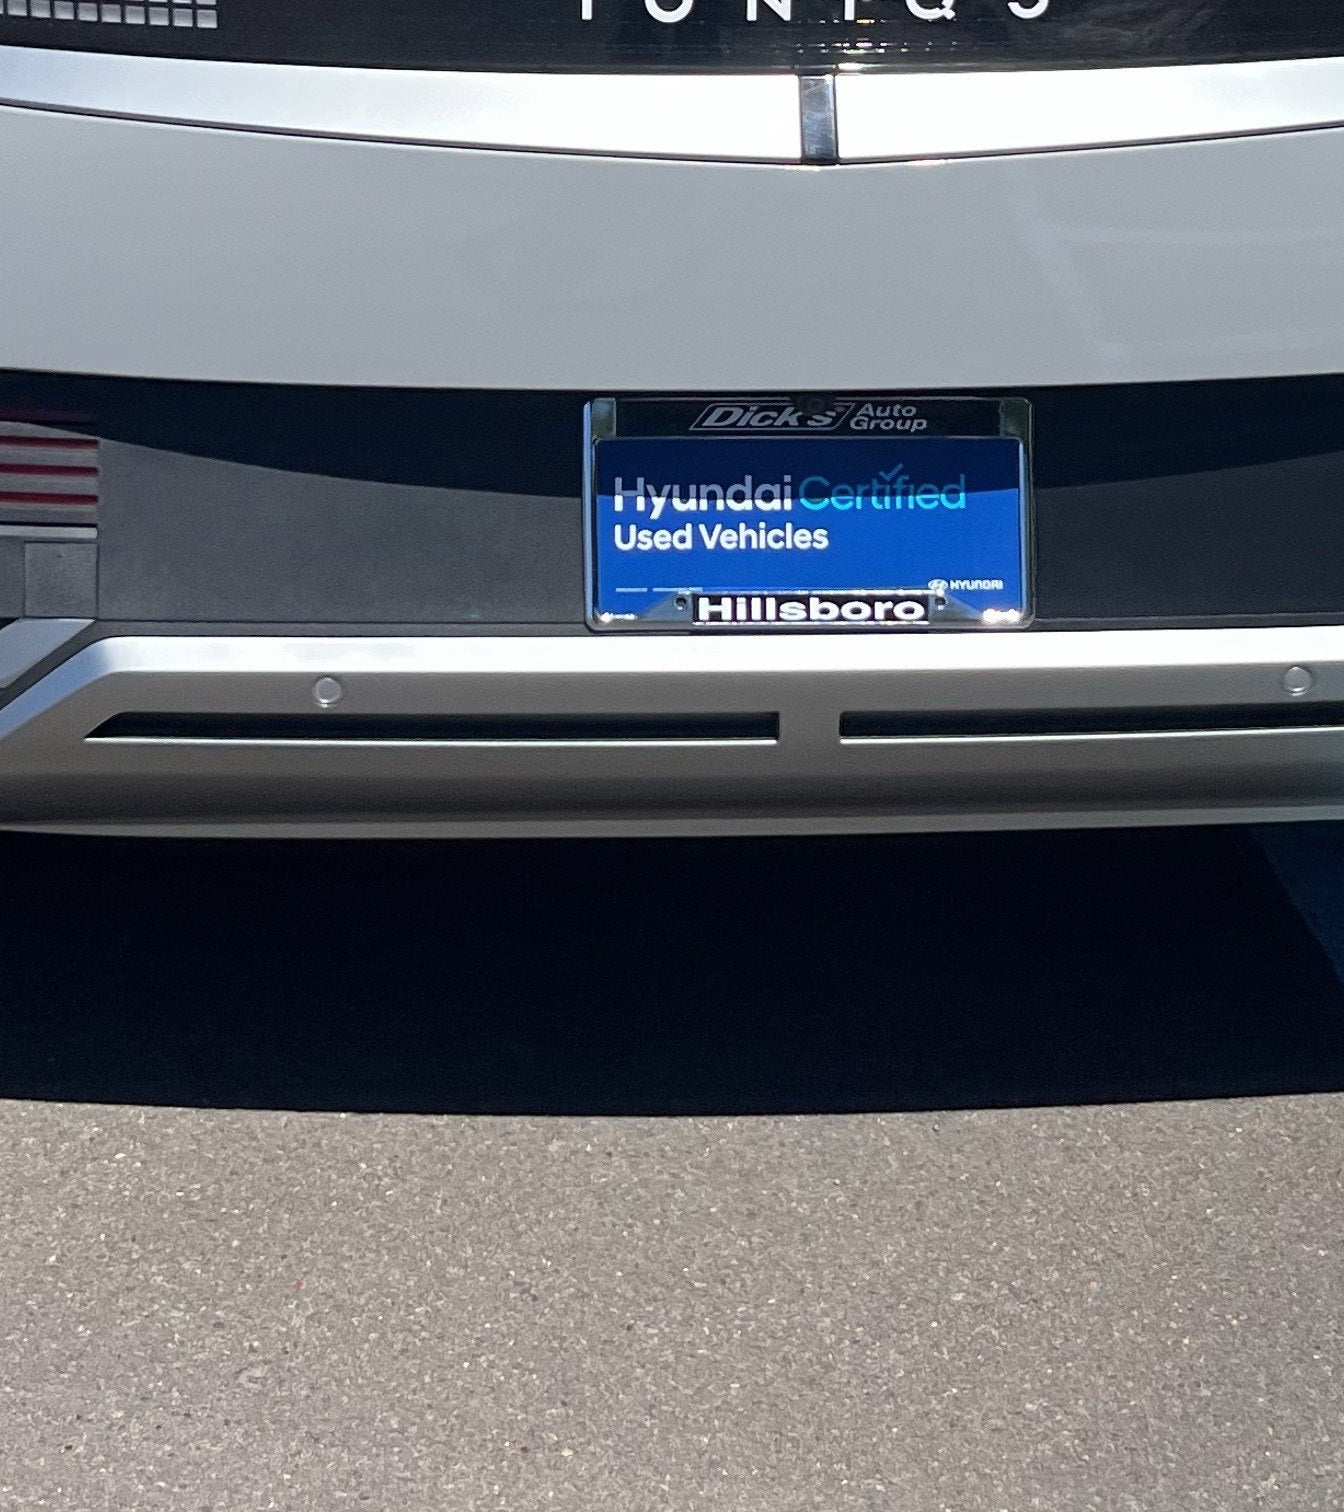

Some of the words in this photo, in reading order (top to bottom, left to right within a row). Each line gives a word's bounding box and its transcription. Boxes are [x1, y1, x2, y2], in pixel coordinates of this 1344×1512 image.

[701, 405, 837, 427] Dicks
[856, 402, 918, 418] Auto
[849, 416, 928, 433] Group
[613, 474, 793, 520] Hyundai
[798, 462, 966, 511] Certified
[613, 522, 693, 551] Used
[698, 521, 830, 551] Vehicles
[949, 579, 1004, 591] HYUNDAI
[697, 596, 926, 622] Hillsboro
